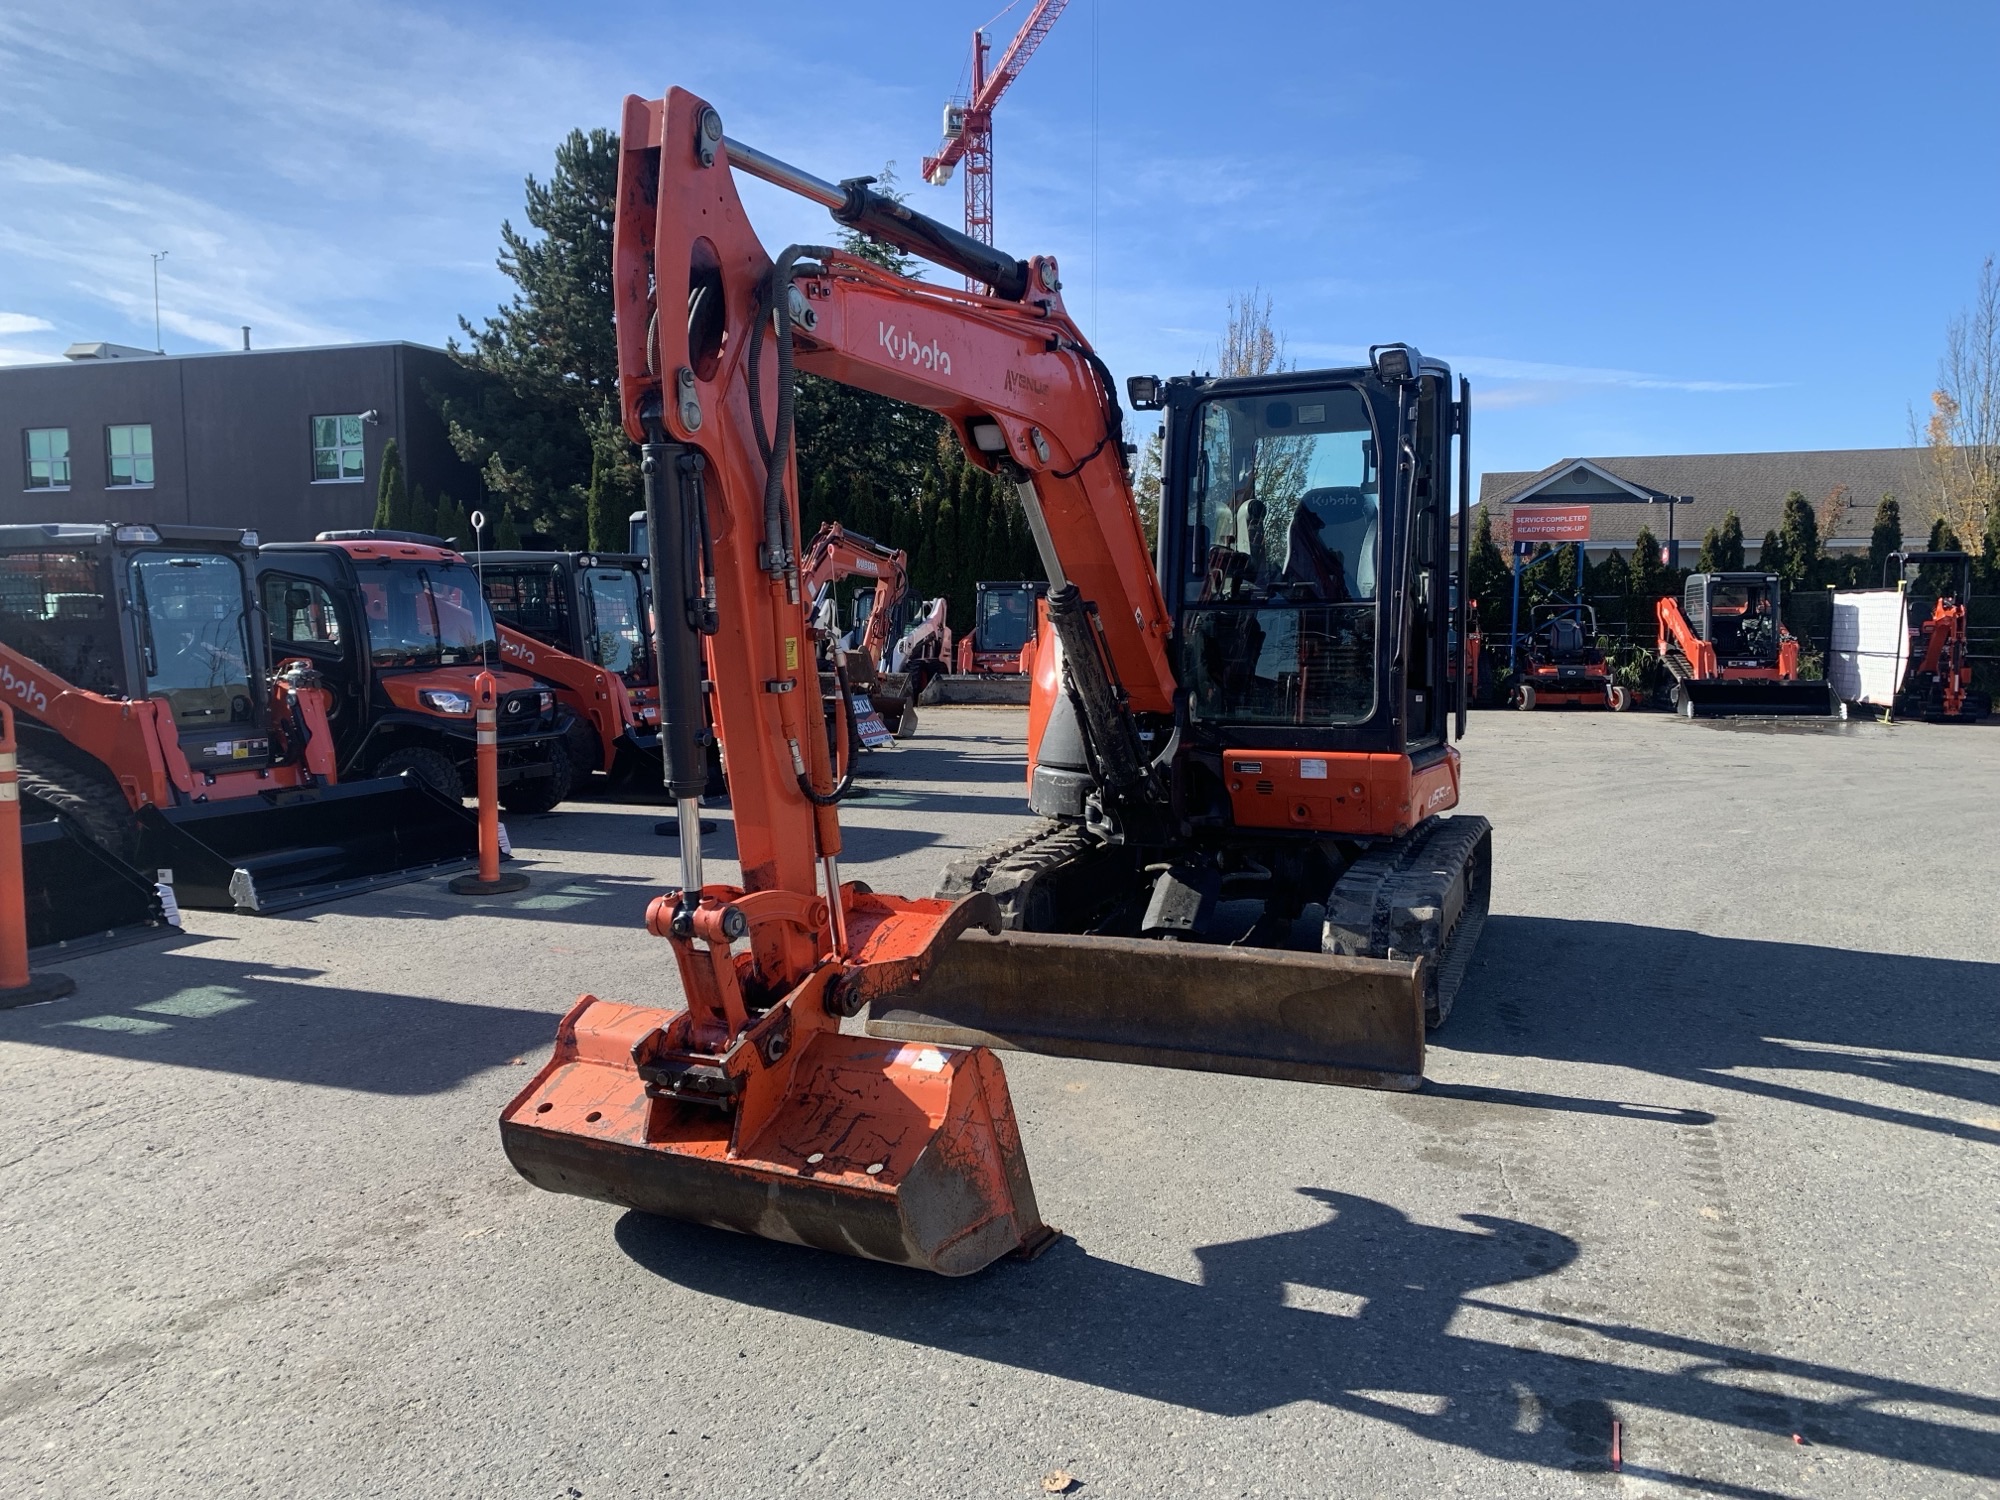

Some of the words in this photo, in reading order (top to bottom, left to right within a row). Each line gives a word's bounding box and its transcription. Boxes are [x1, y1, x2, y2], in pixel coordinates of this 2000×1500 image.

[879, 321, 951, 375] Kubota
[1311, 494, 1357, 506] Kubota
[1546, 515, 1587, 523] COMPLETED
[499, 634, 535, 665] bota
[0, 665, 47, 712] bota
[852, 699, 872, 715] EKLY
[857, 720, 887, 736] SPECIAL
